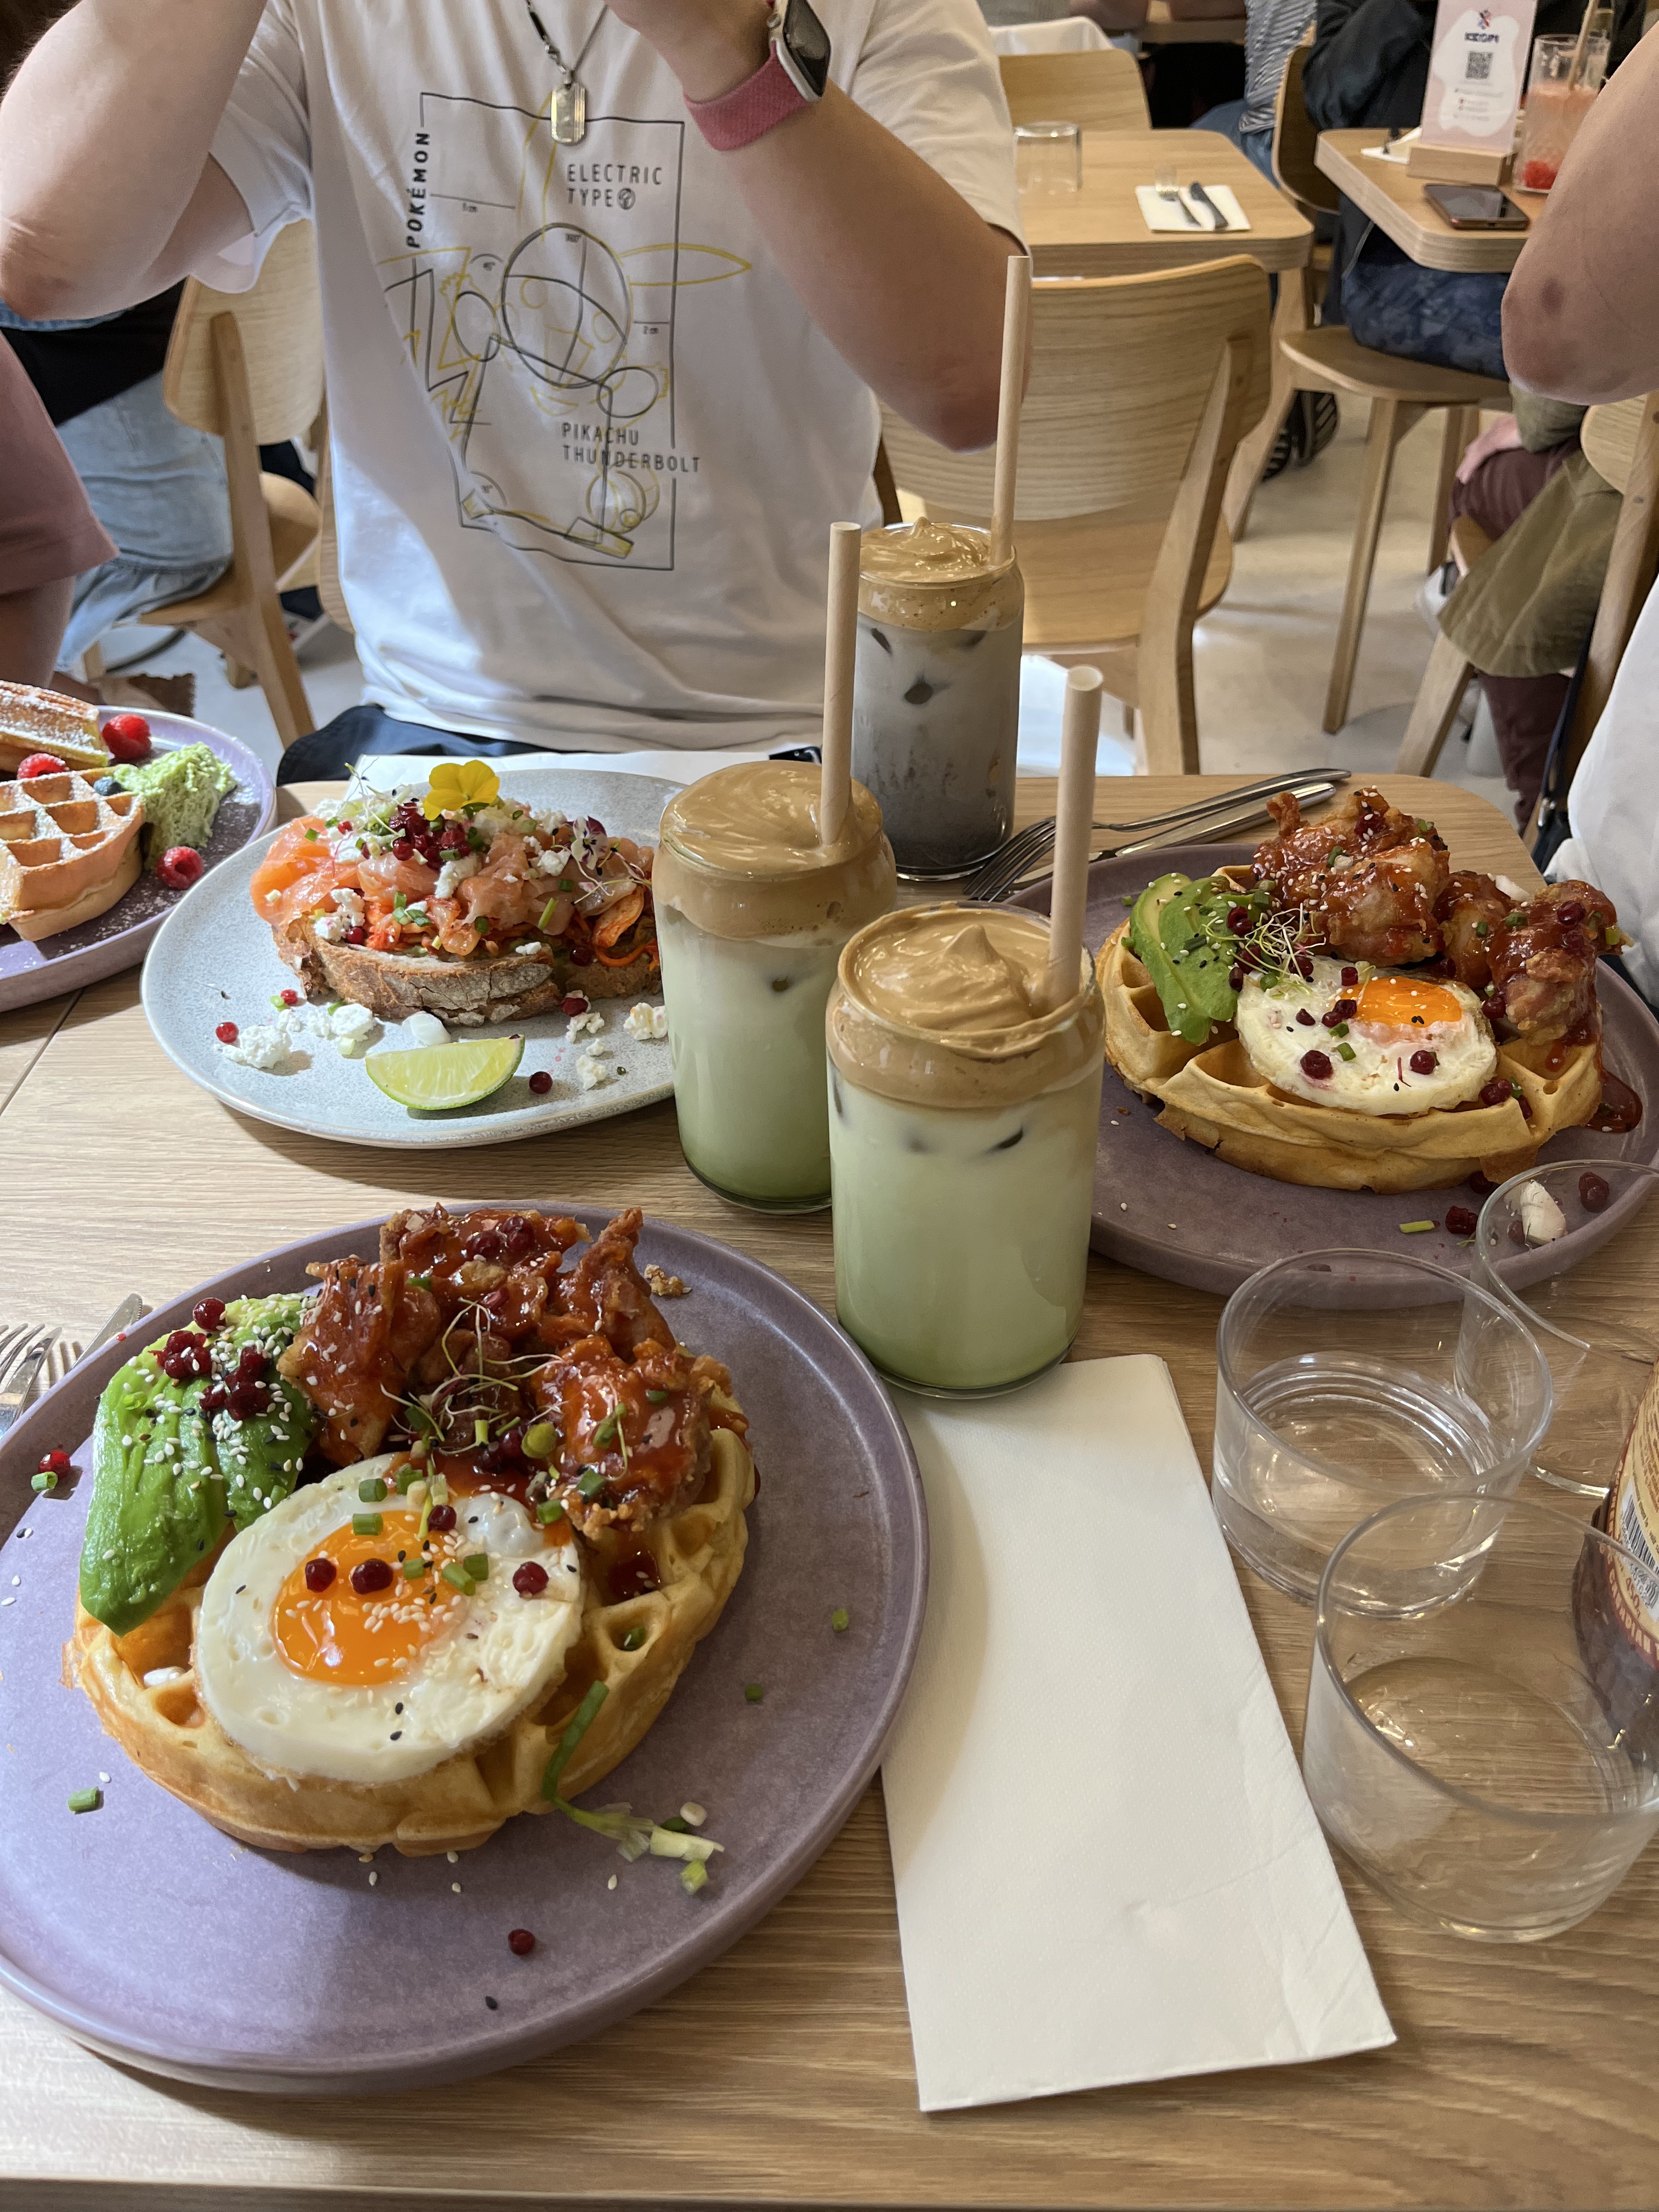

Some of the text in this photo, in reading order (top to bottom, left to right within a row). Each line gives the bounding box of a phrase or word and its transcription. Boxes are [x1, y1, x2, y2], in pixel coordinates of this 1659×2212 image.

[567, 163, 663, 185] ELECTRIC
[406, 133, 430, 249] POKÉMON
[567, 187, 613, 207] TYPE
[562, 422, 639, 446] PIKACHU
[563, 445, 700, 473] THUNDERBOLT
